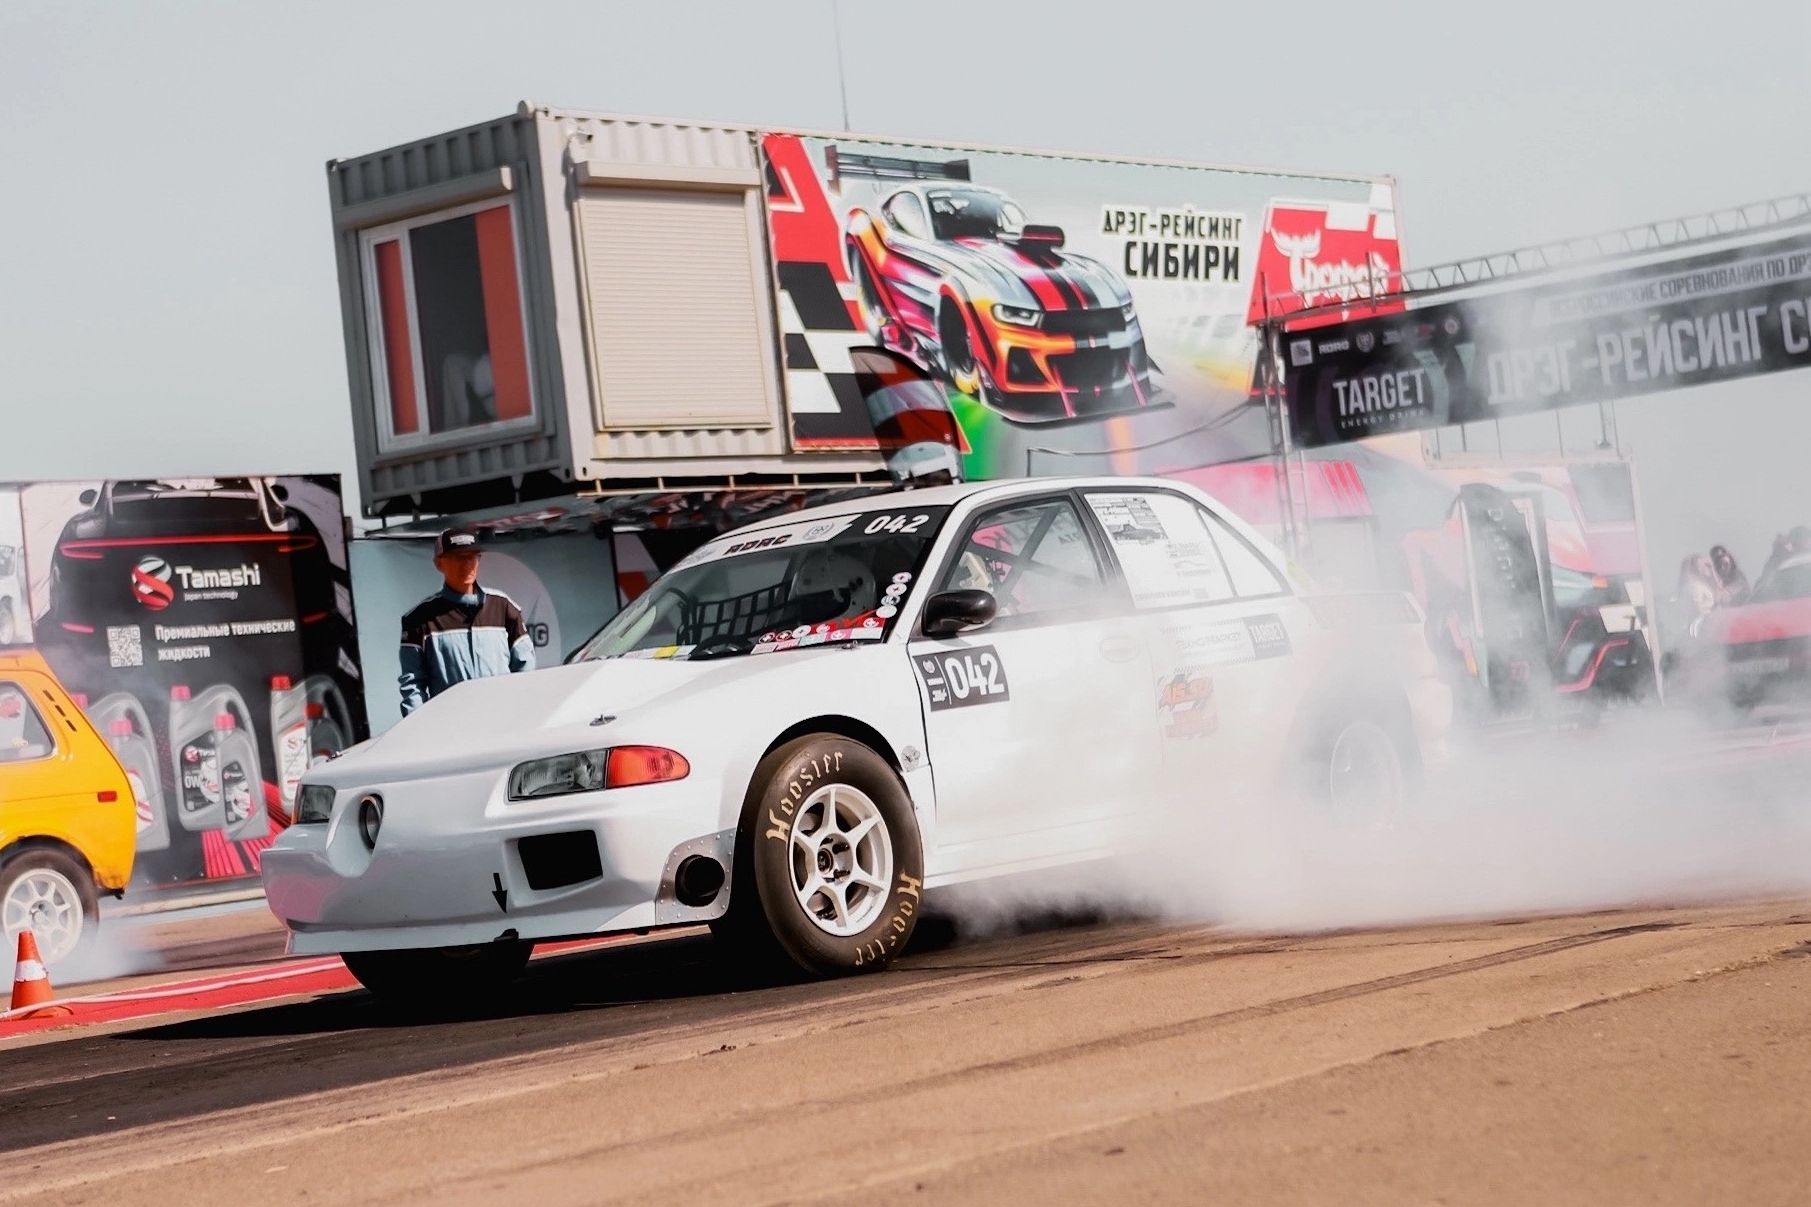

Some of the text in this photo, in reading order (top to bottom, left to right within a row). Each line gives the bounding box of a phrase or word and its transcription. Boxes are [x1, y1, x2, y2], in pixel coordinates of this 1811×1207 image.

[1103, 209, 1242, 240] ДРЭГ-РЕЙСИНГ
[1125, 241, 1240, 281] СИБИРИ
[1659, 262, 1764, 301] СОРЕВНОВАНИЯ
[1766, 259, 1785, 279] ПО
[1487, 298, 1811, 404] ДРЭГ-РЕЙСИНГ С
[1332, 368, 1426, 416] TARGET
[863, 514, 930, 535] 042
[175, 562, 261, 589] Tamashi
[155, 619, 296, 642] Премиальные технические
[944, 653, 1005, 699] 042
[766, 751, 843, 843] Hoosier
